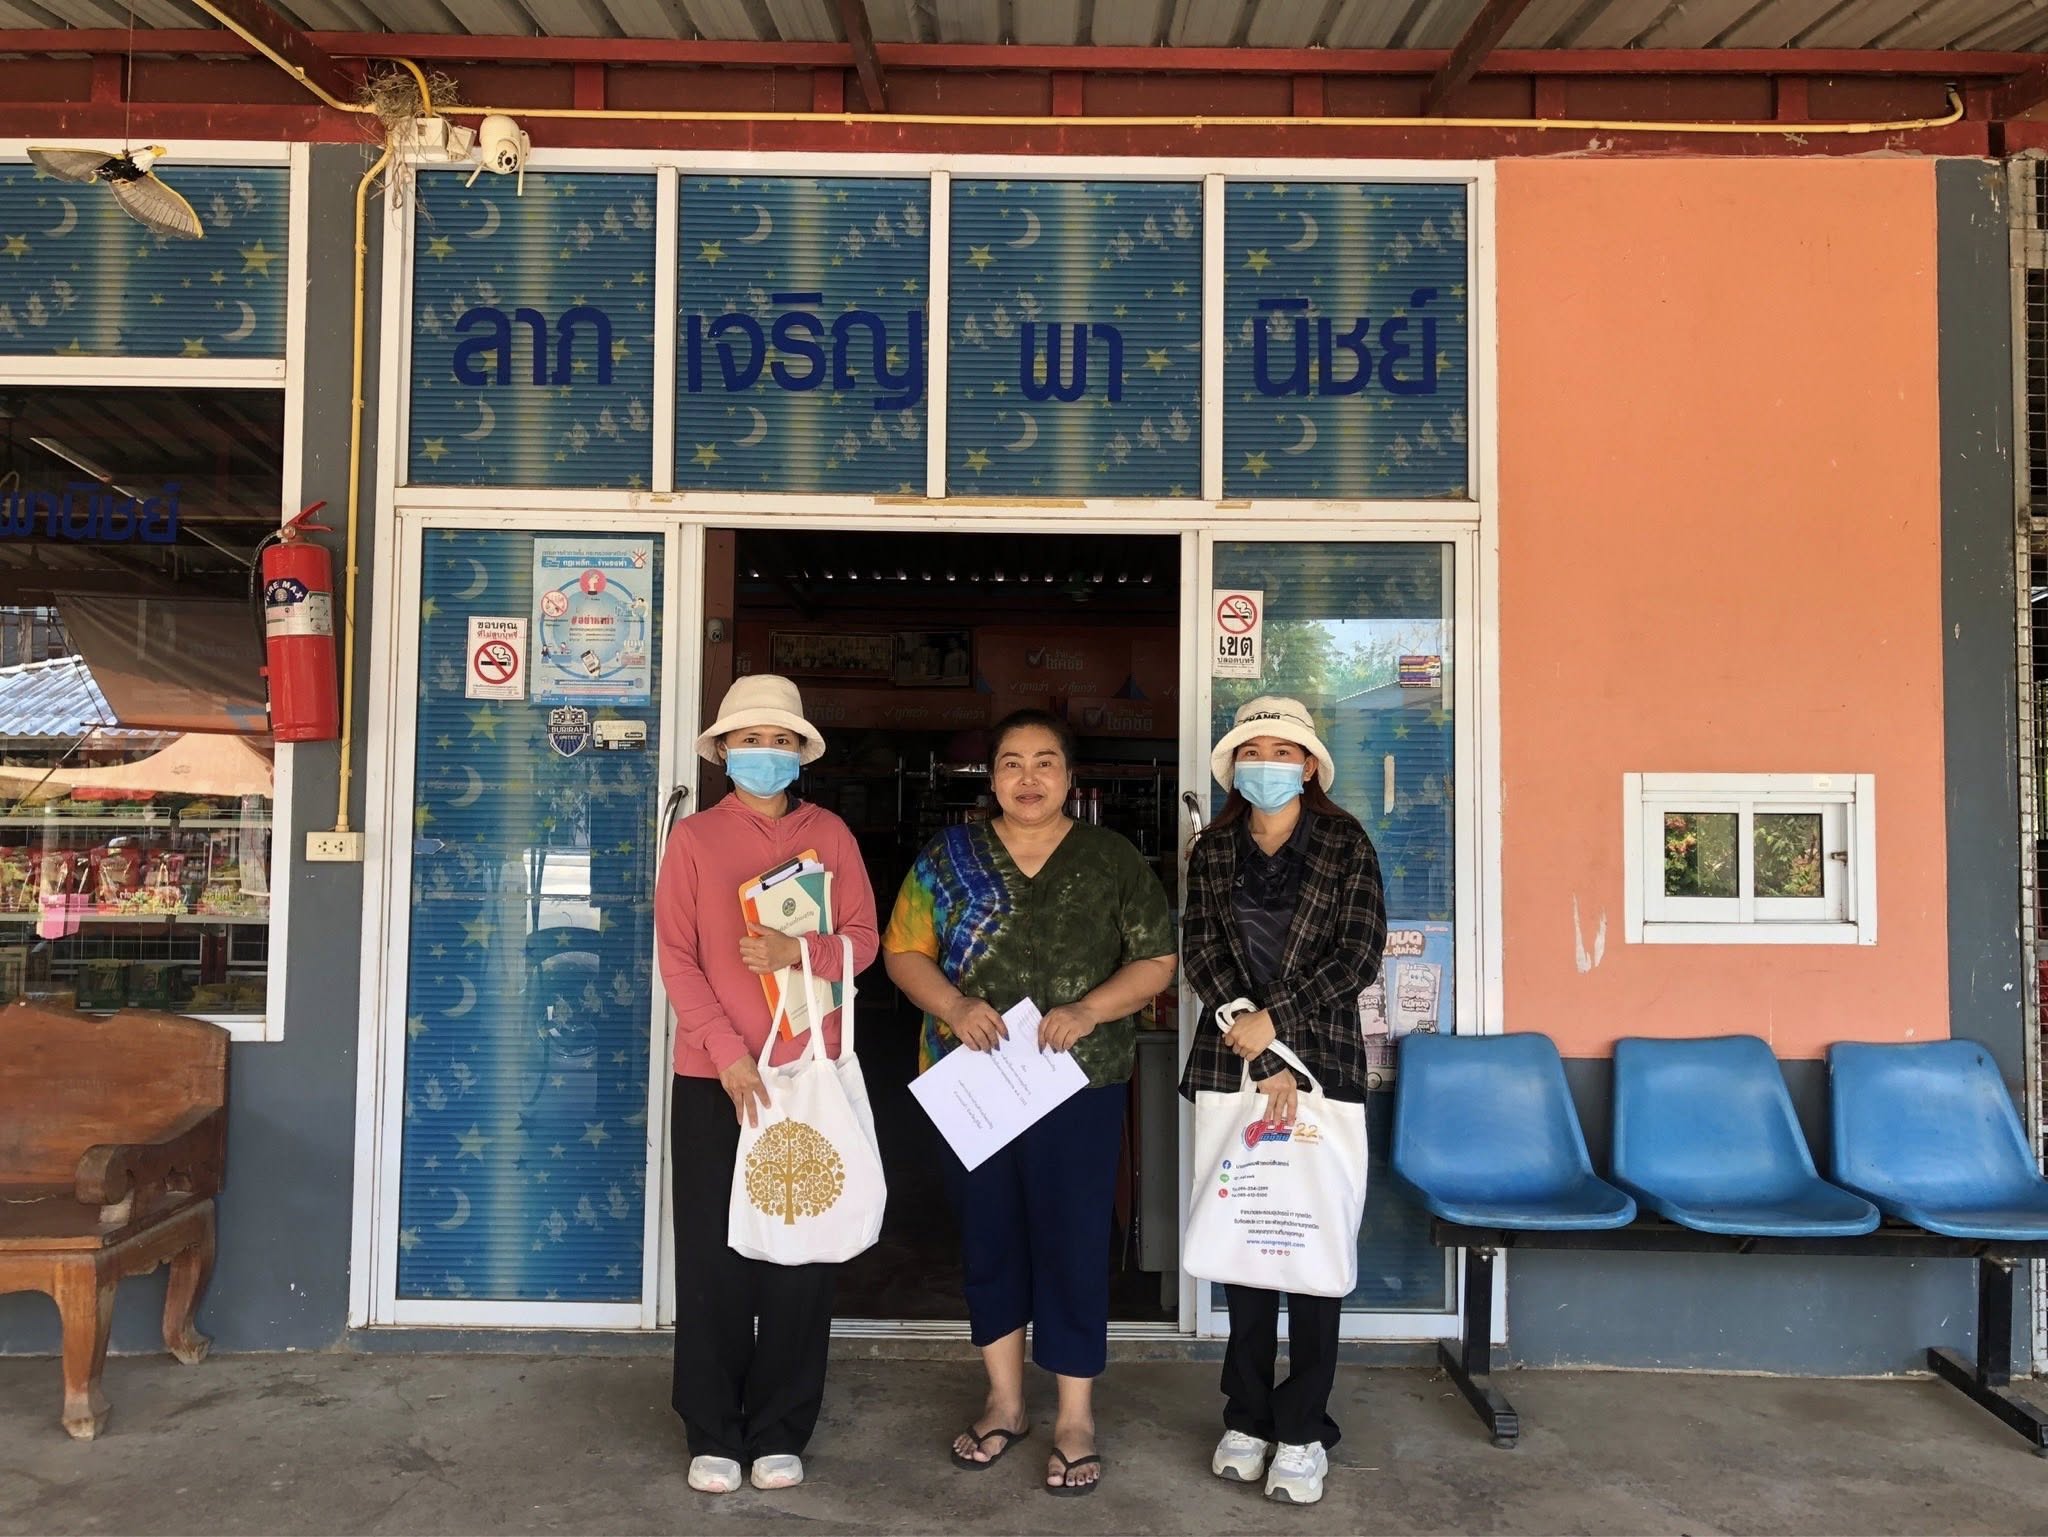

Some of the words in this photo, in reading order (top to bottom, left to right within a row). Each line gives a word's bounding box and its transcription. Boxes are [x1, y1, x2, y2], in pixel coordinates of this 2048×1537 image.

[454, 307, 612, 386] ลาภ
[688, 293, 923, 411] เจริญ
[1020, 322, 1124, 403] พา
[282, 581, 304, 598] MAX
[477, 621, 518, 632] ขอบคุณ
[1219, 636, 1253, 656] เขต
